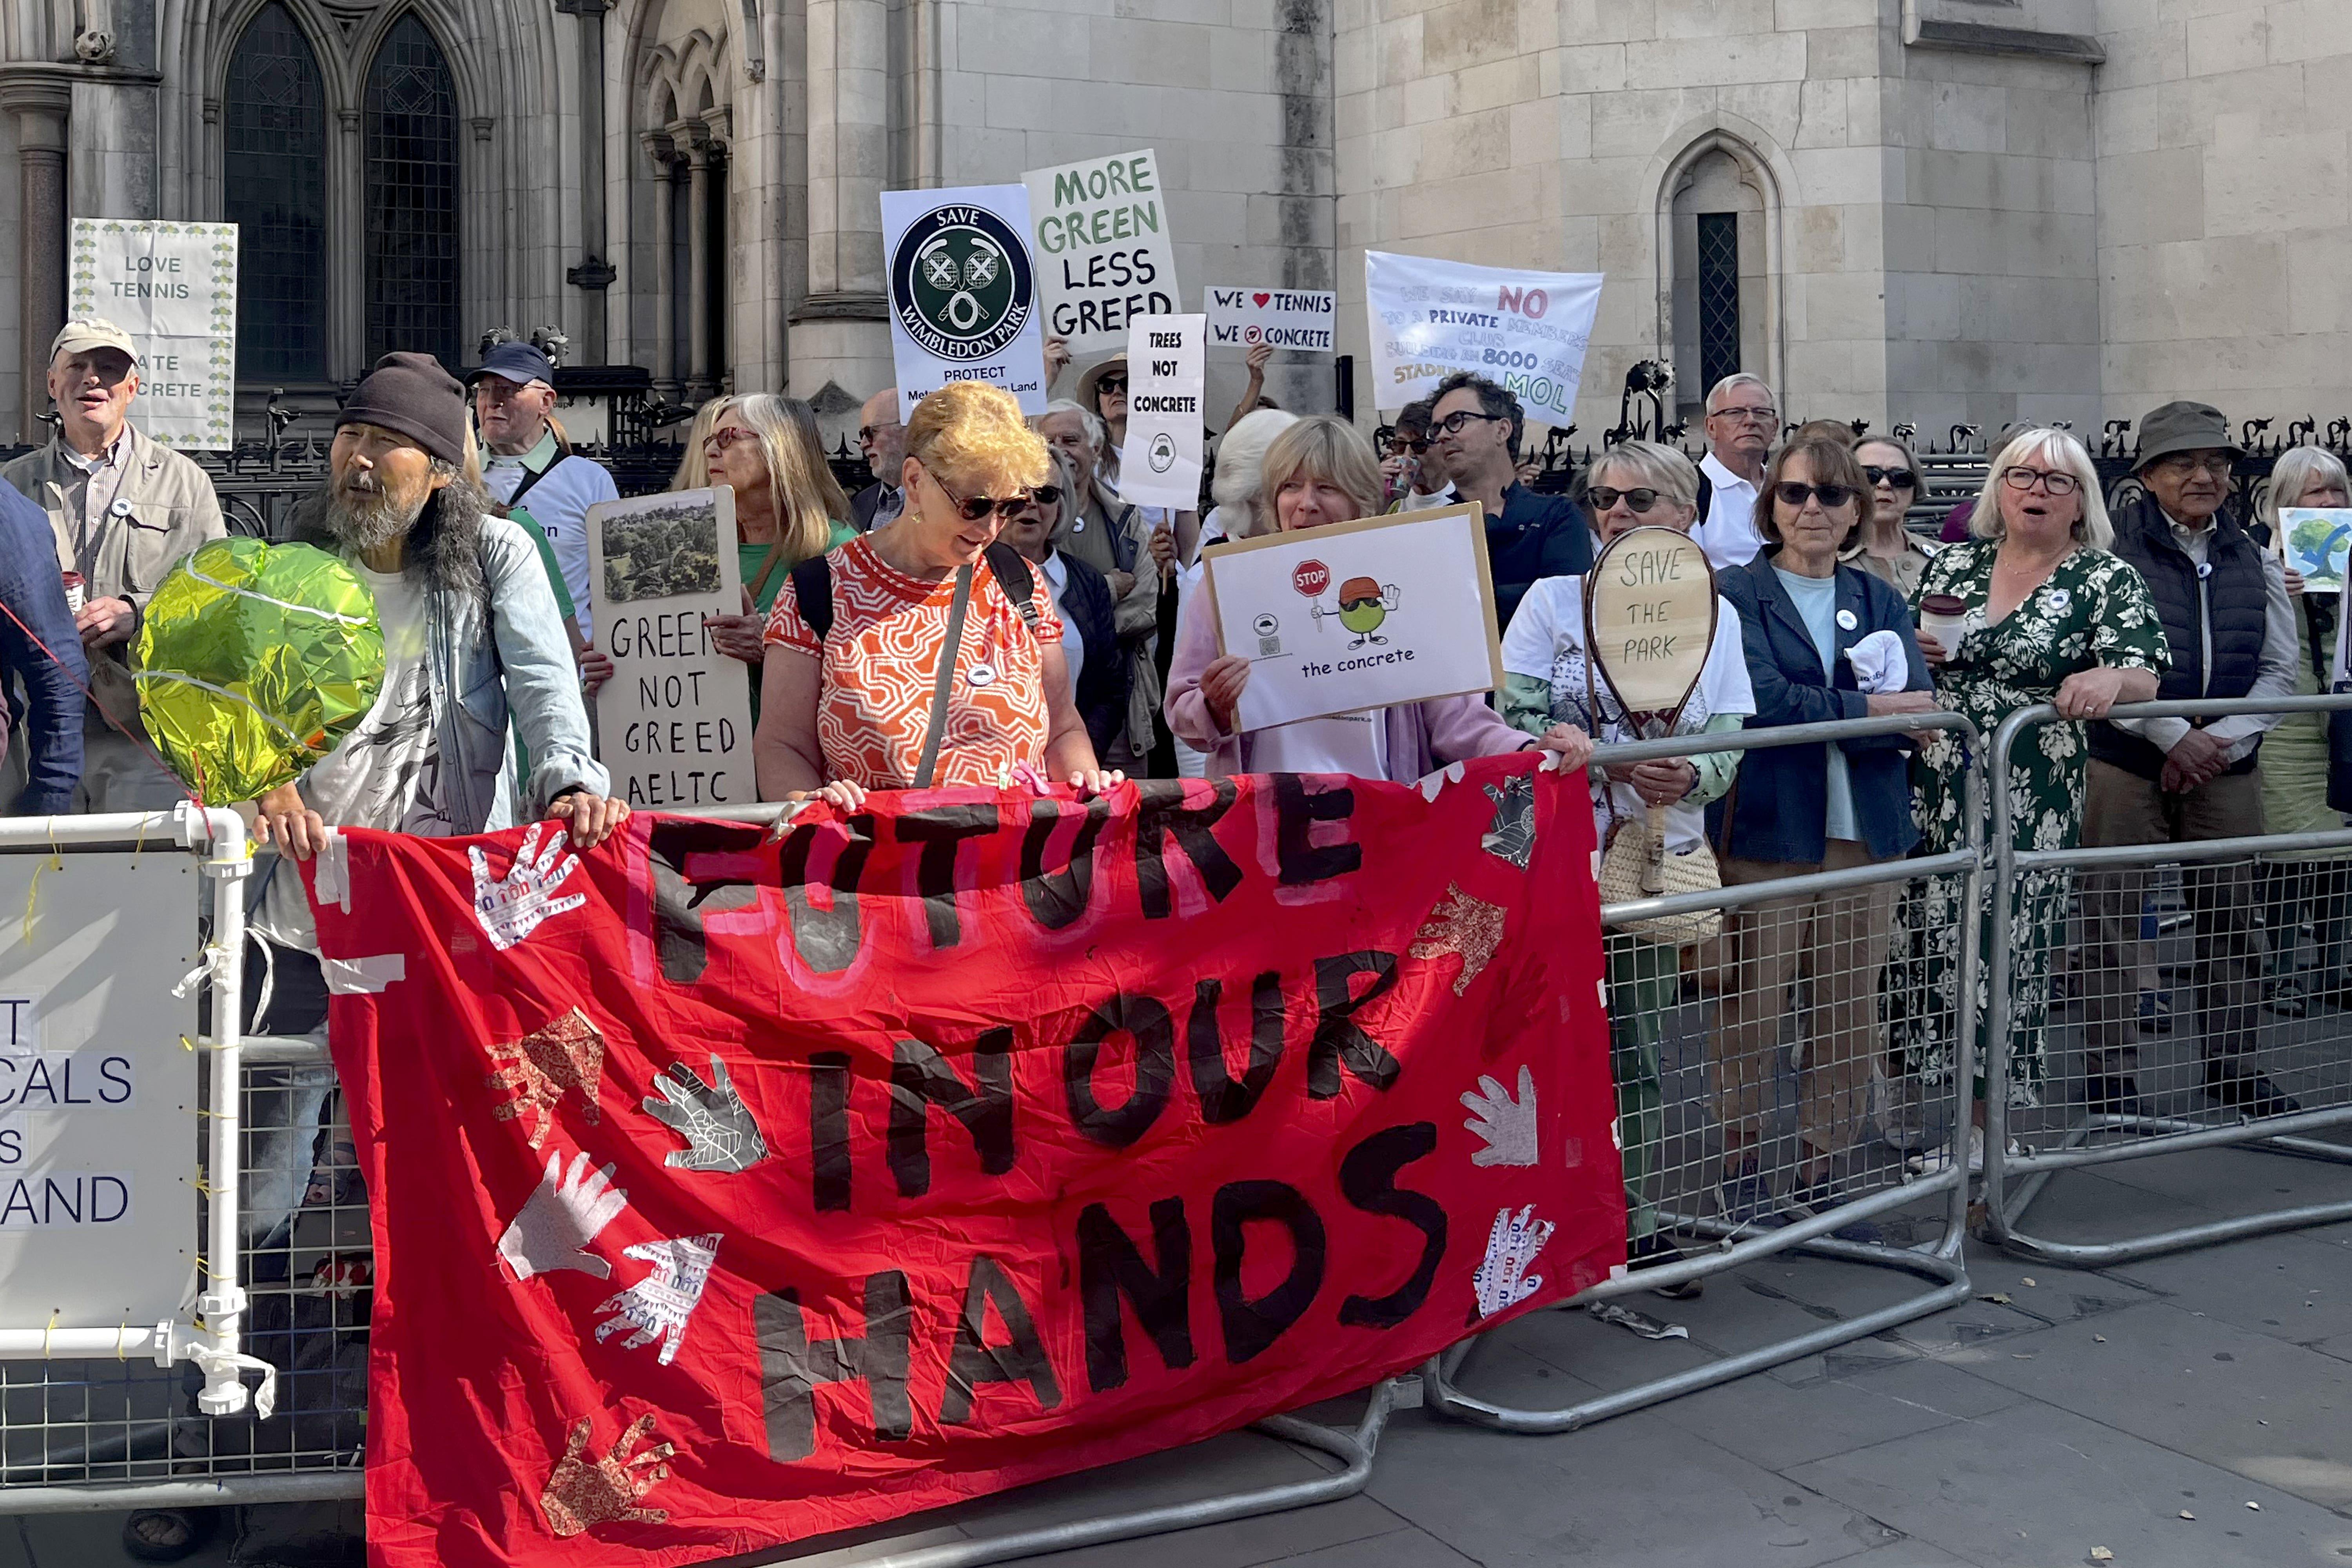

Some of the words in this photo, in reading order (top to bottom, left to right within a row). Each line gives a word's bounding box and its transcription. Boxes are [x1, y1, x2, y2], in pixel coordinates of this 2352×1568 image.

[1054, 157, 1154, 207] MORE
[936, 208, 979, 226] SAVE
[1038, 201, 1159, 254] GREEN
[125, 256, 181, 272] LOVE
[1063, 249, 1156, 290] LESS
[110, 282, 189, 299] TENNIS
[1214, 290, 1243, 309] WE
[1274, 294, 1332, 313] TENNIS
[1399, 286, 1430, 302] WE
[1439, 286, 1479, 304] SAY
[1497, 285, 1549, 319] NO
[902, 304, 996, 358] WIMBLEDON
[996, 303, 1028, 345] PARK
[1149, 332, 1181, 348] TREES
[1213, 325, 1239, 343] WE
[1265, 327, 1330, 348] CONCRETE
[1429, 309, 1499, 328] PRIVATE
[1507, 318, 1589, 352] MEMBERS
[1458, 331, 1506, 348] CLUB
[138, 354, 179, 370] ATE
[1152, 360, 1178, 377] NOT
[1482, 348, 1538, 370] 8000
[944, 366, 1006, 381] PROTECT
[1011, 381, 1037, 392] Land
[137, 382, 201, 397] CRETE
[1505, 371, 1567, 415] MOL
[1134, 396, 1196, 413] CONCRETE
[1296, 570, 1326, 586] STOP
[1620, 548, 1686, 587] SAVE
[1626, 600, 1672, 624] THE
[1624, 635, 1677, 664] PARK
[1301, 661, 1332, 678] the
[1337, 648, 1416, 671] concrete
[639, 671, 706, 712] NOT
[626, 717, 735, 755] GREED
[628, 770, 728, 806] AELTC
[649, 773, 1364, 984] FUTURE
[809, 1025, 1017, 1212] IN
[1063, 949, 1400, 1149] OUR
[753, 1121, 1448, 1462] HANDS
